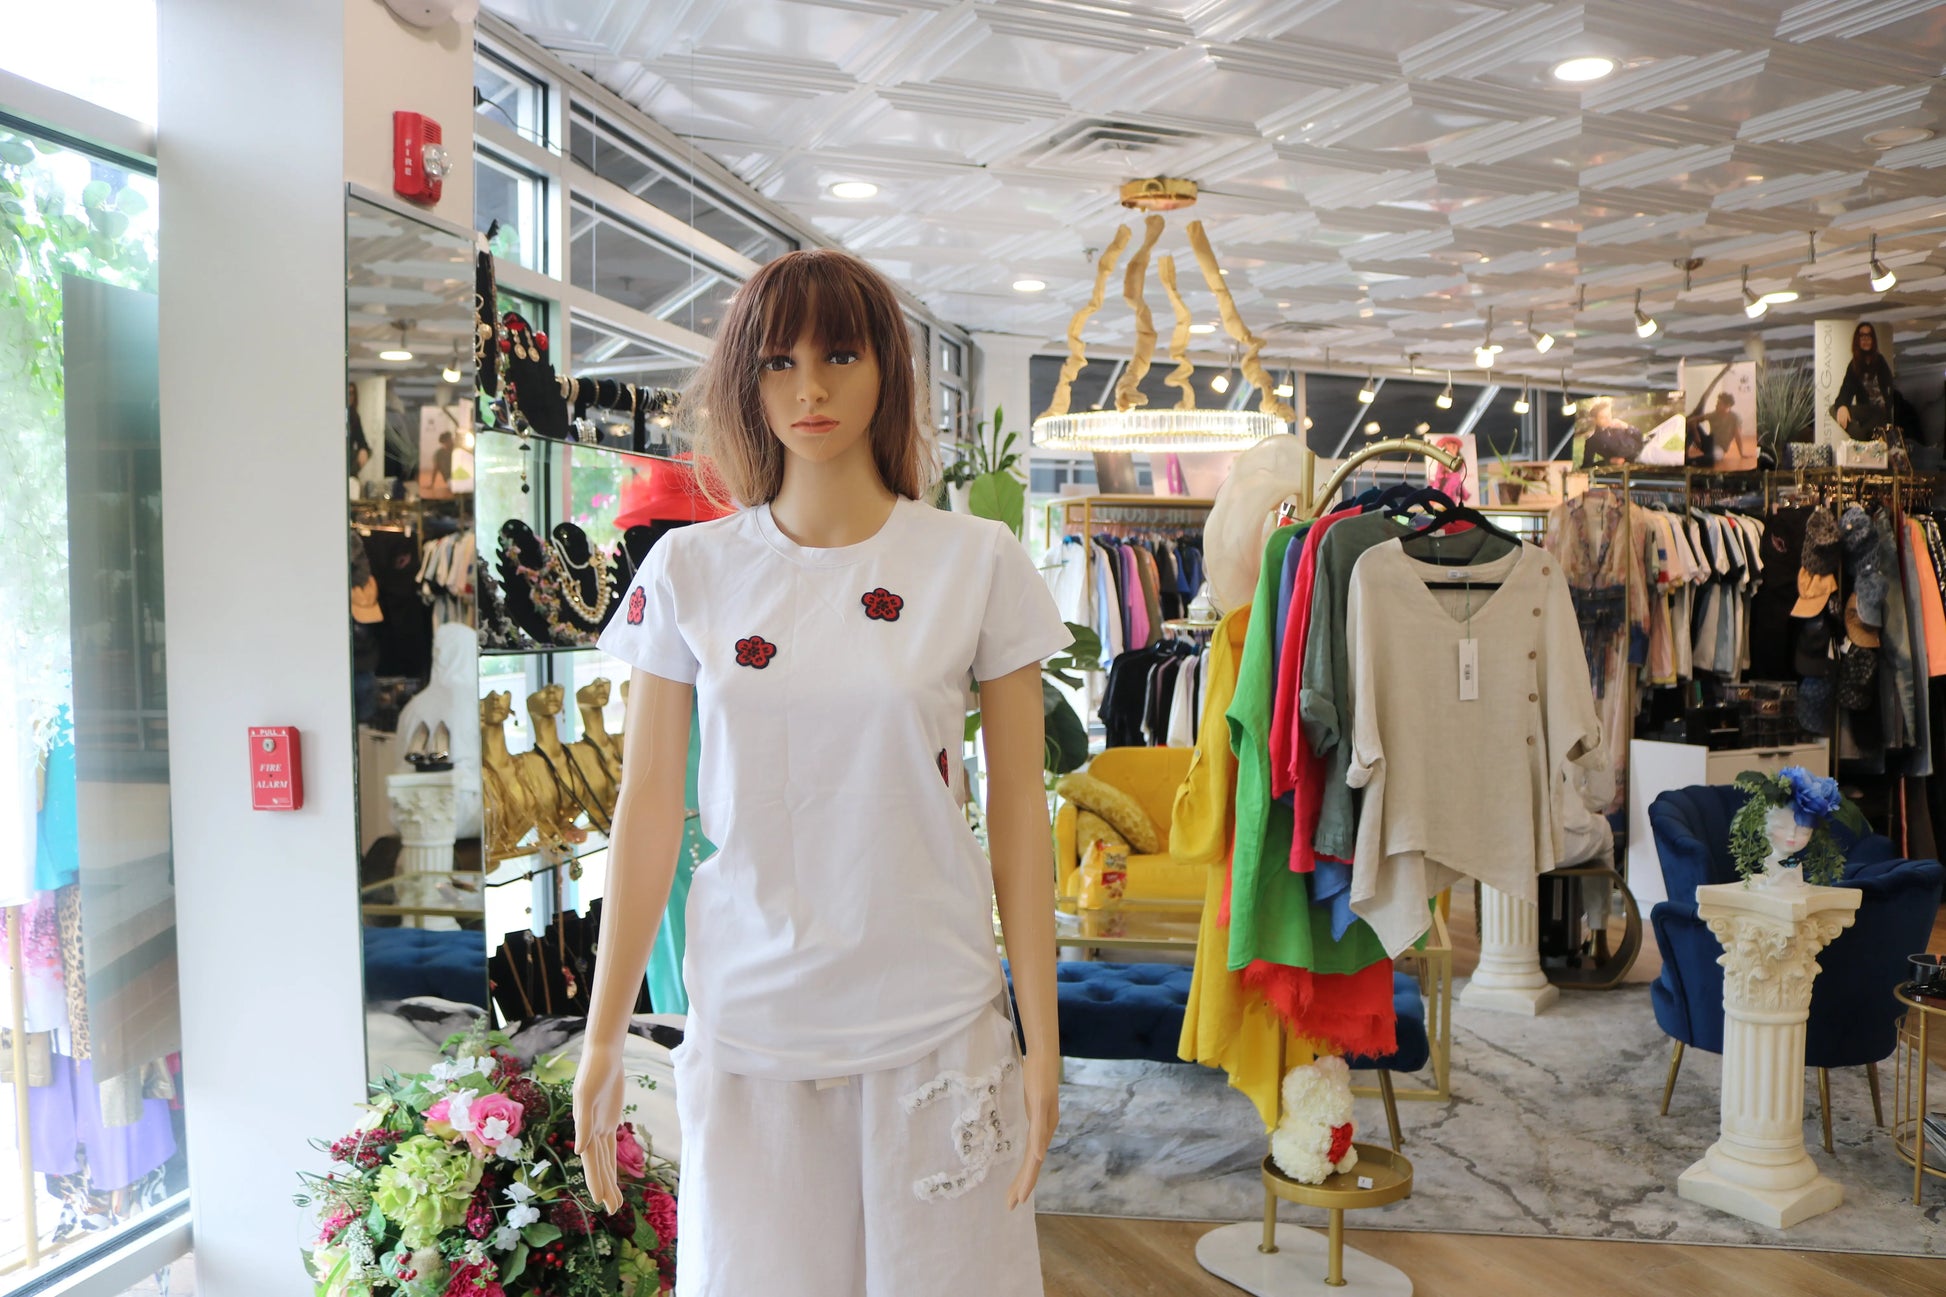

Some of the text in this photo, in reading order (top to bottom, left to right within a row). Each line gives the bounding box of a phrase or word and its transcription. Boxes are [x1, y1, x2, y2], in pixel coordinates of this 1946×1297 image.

[404, 138, 412, 176] FIRE
[259, 763, 282, 772] FIRE
[256, 780, 289, 789] ALARM
